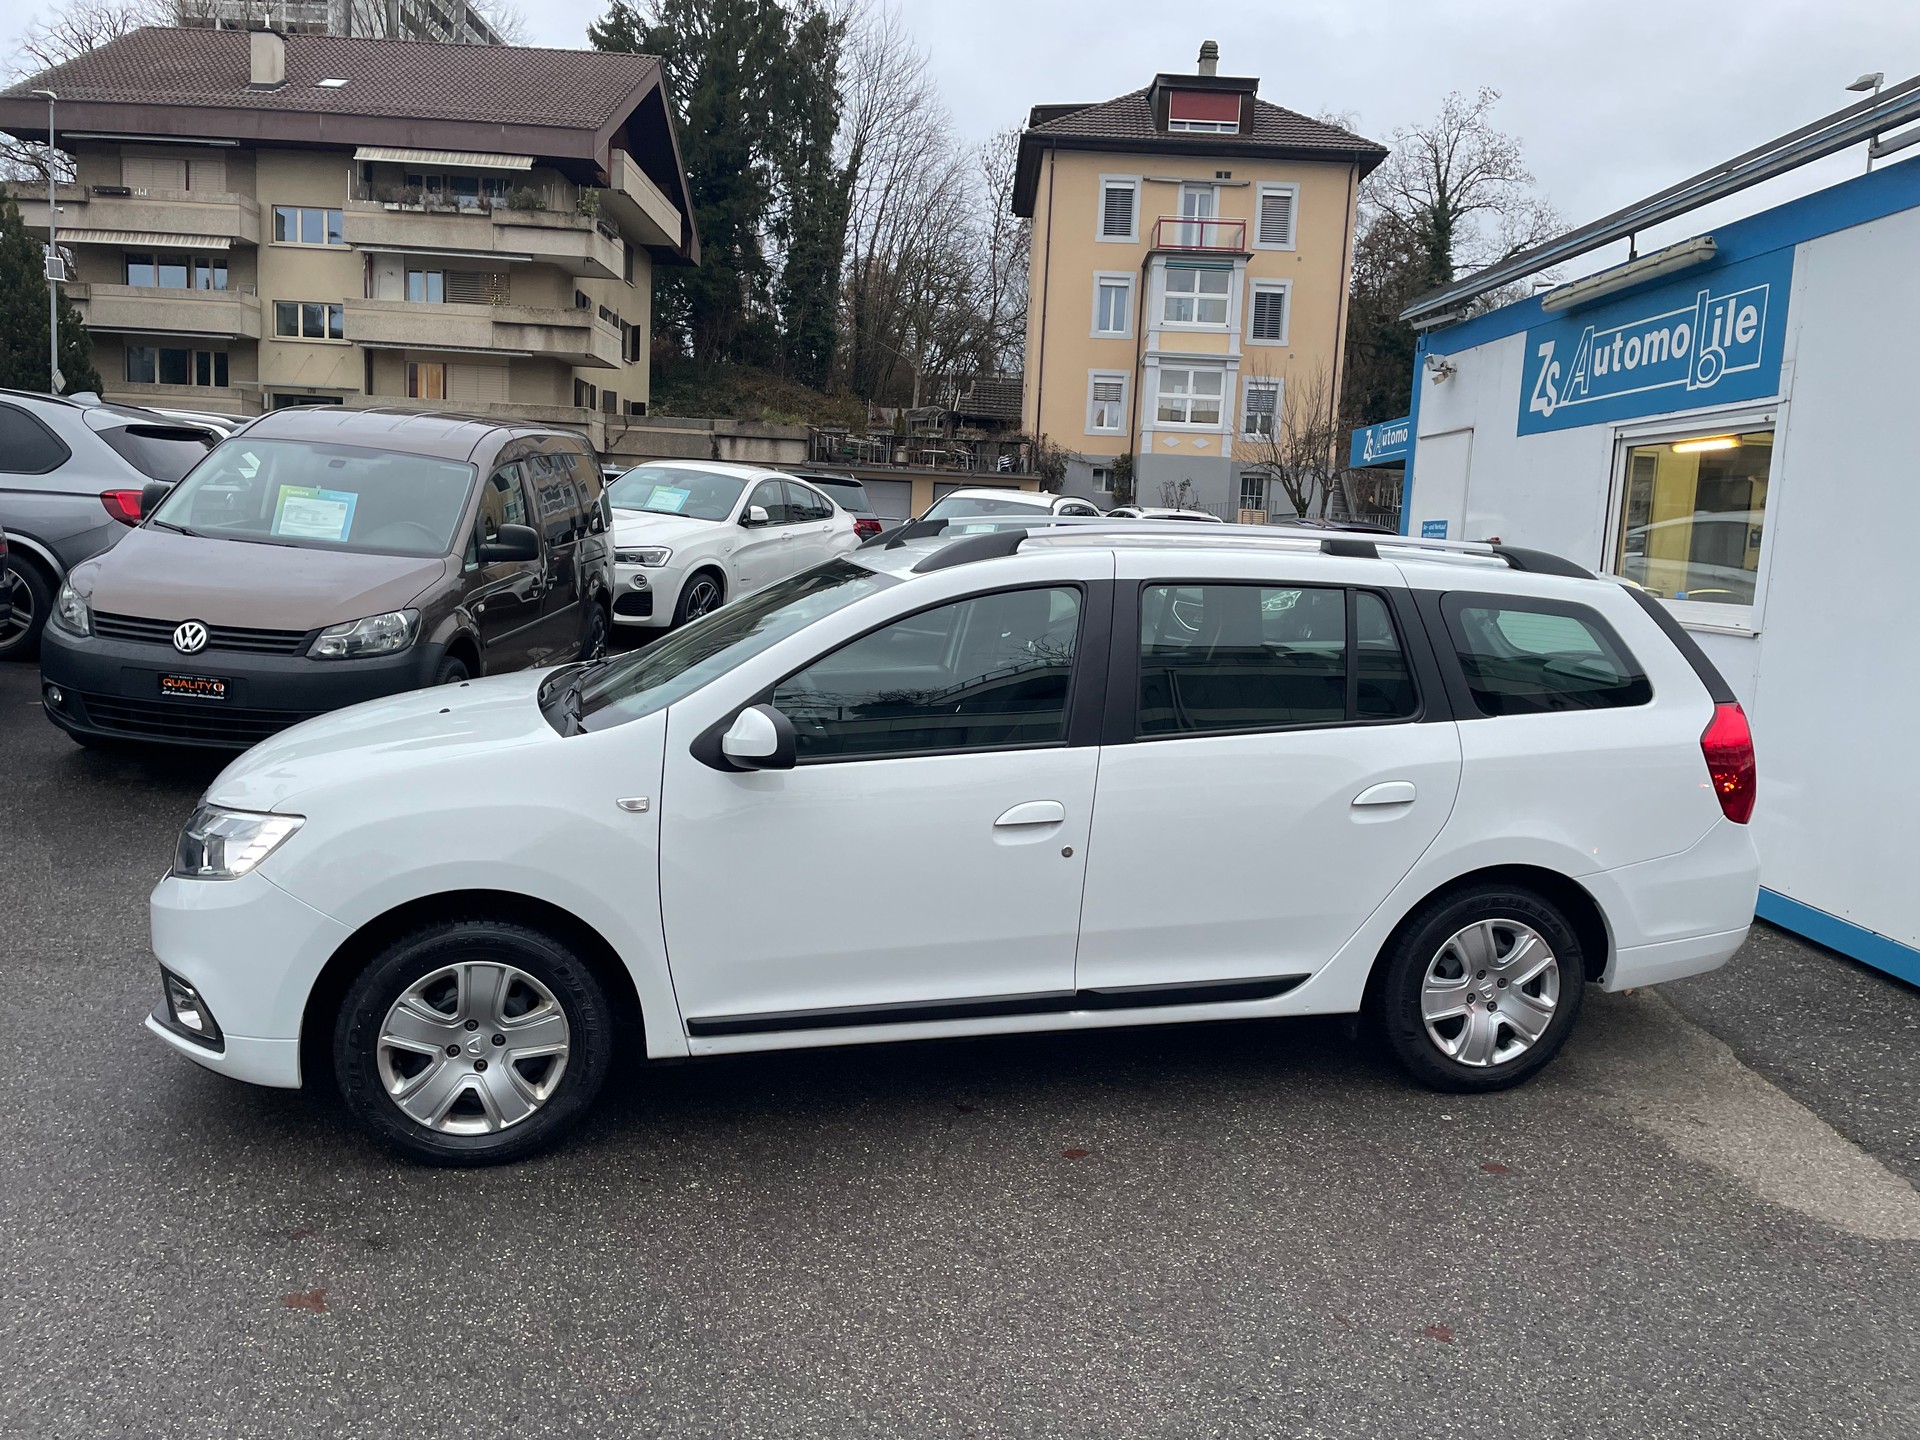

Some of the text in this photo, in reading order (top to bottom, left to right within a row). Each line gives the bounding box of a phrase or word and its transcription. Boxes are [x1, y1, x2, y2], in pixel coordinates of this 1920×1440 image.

[1560, 289, 1758, 402] Automobile
[174, 621, 207, 652] VW
[163, 678, 212, 690] QUALITY
